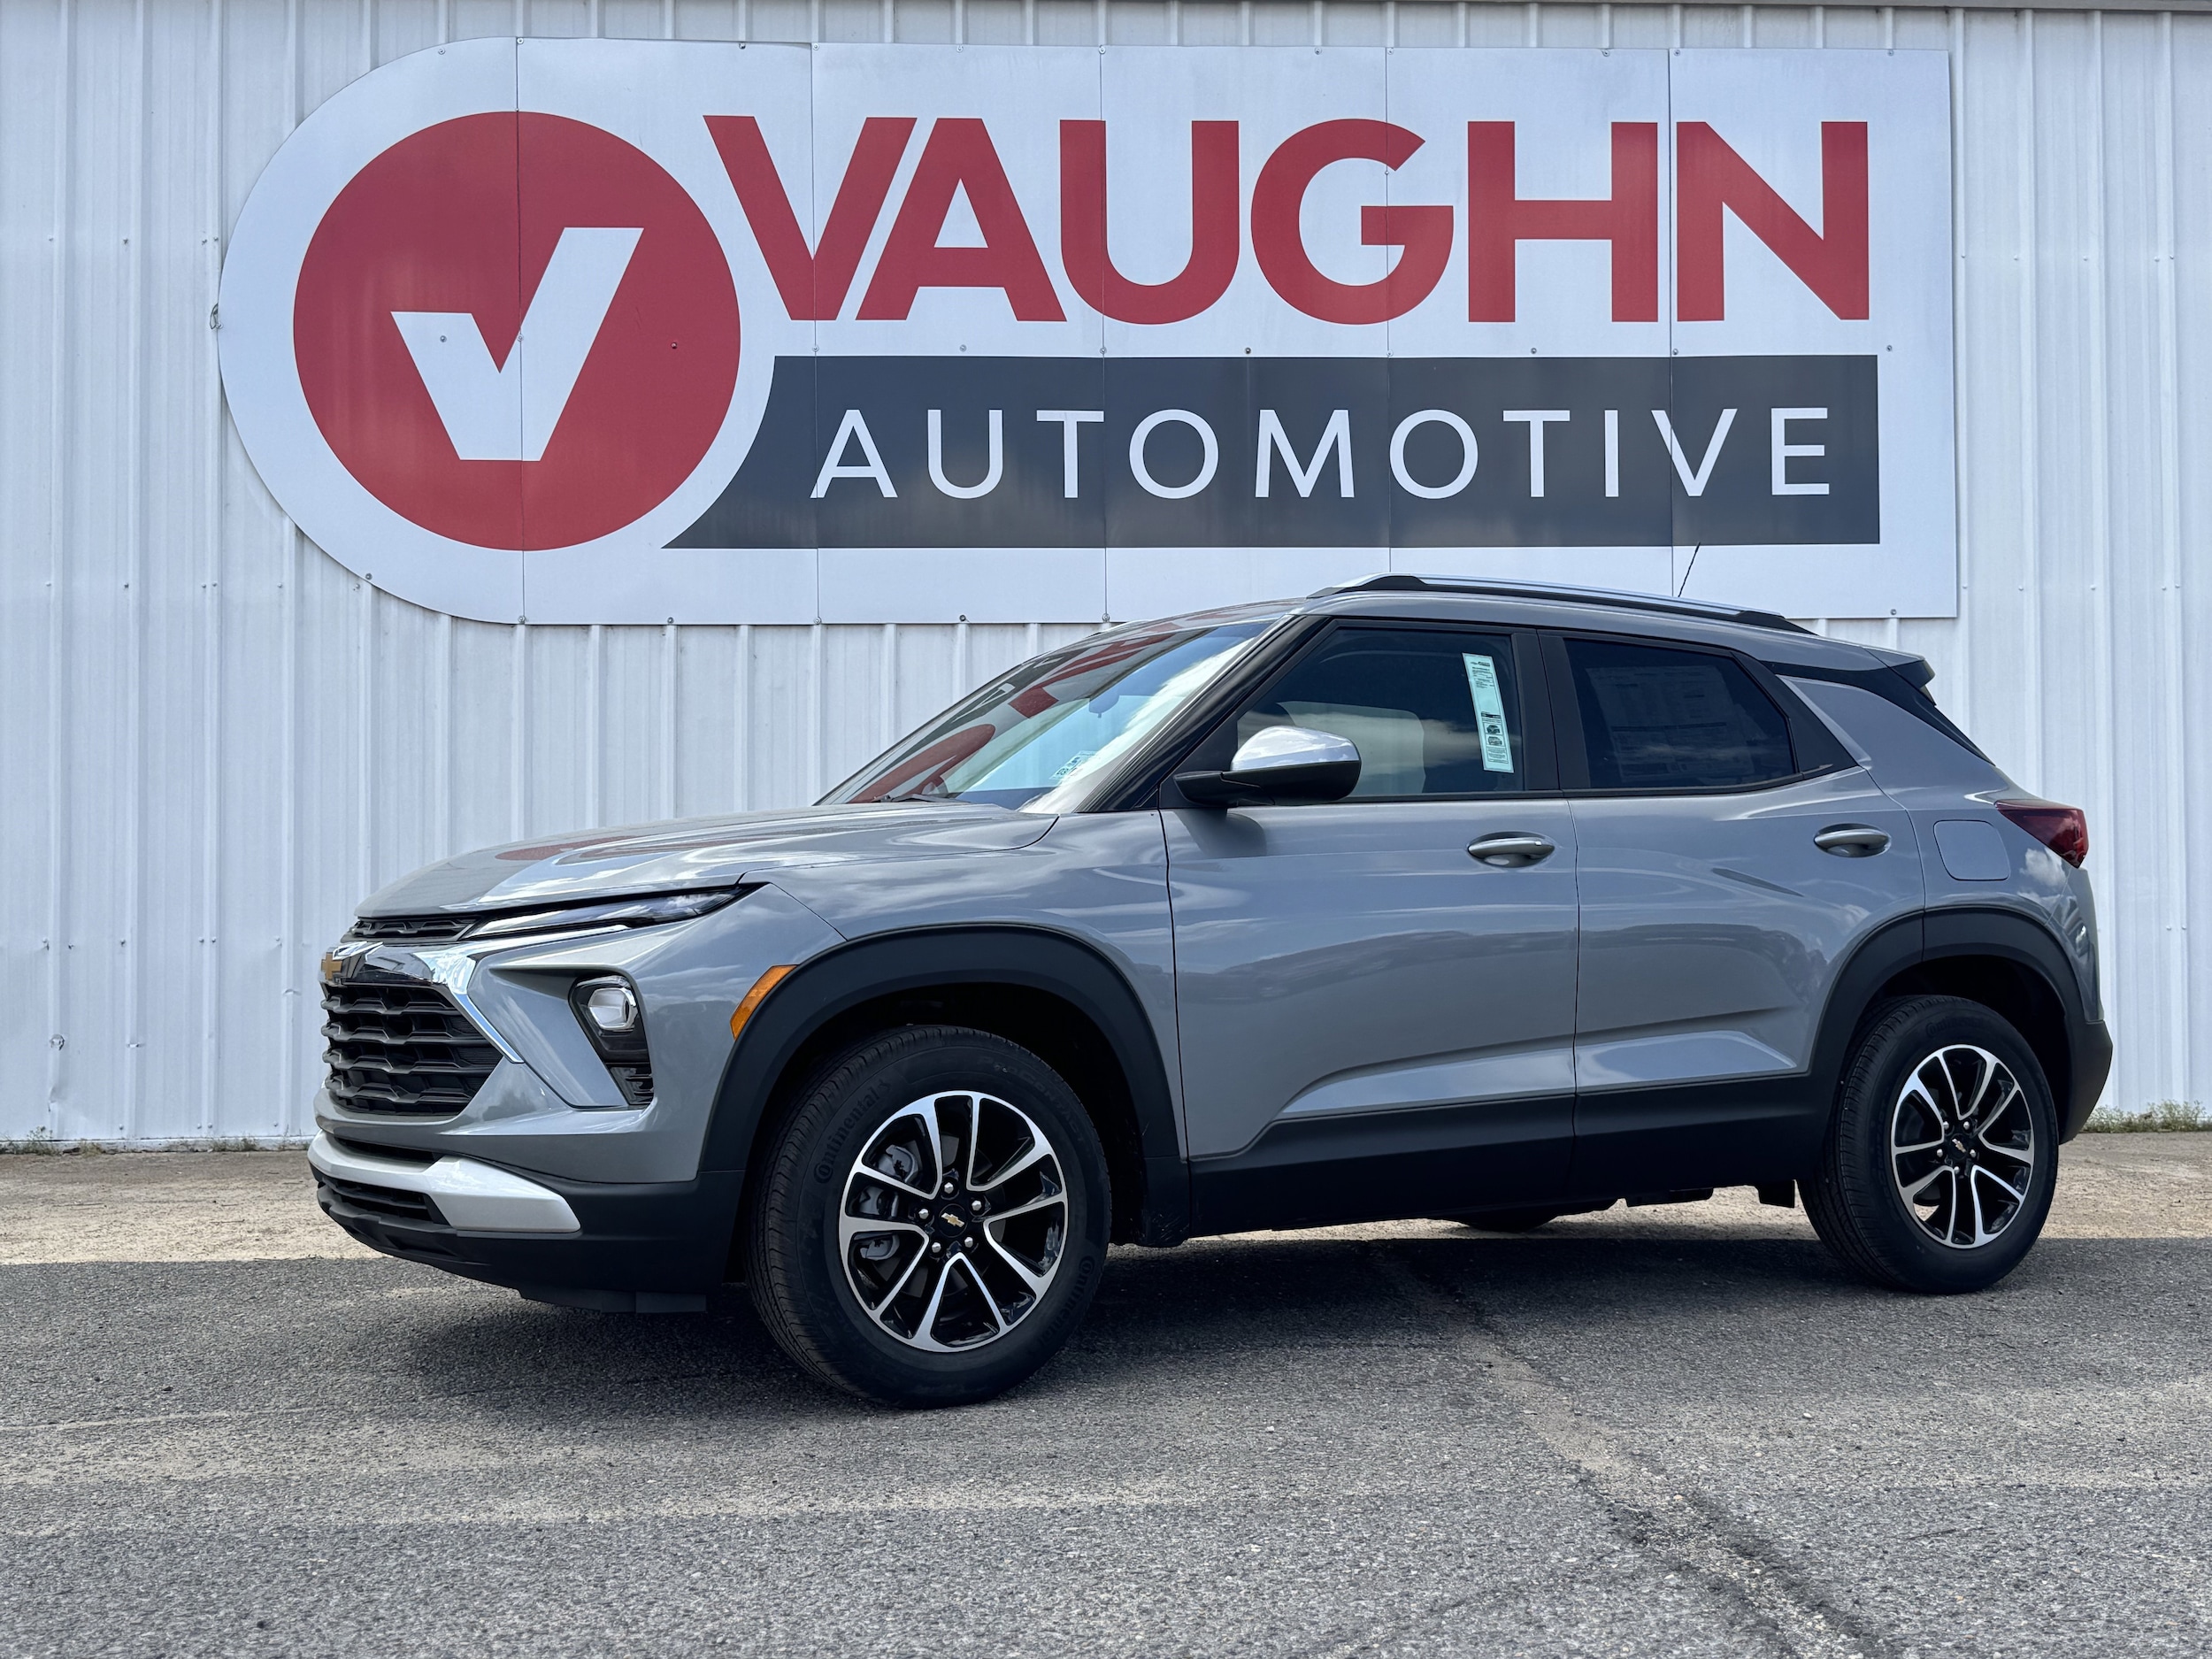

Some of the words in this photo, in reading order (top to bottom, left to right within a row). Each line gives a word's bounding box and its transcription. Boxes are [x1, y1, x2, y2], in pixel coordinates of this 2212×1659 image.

[704, 116, 1869, 325] VAUGHN
[810, 407, 1831, 500] AUTOMOTIVE
[813, 1086, 880, 1184] Continental
[1038, 1256, 1095, 1348] Continental
